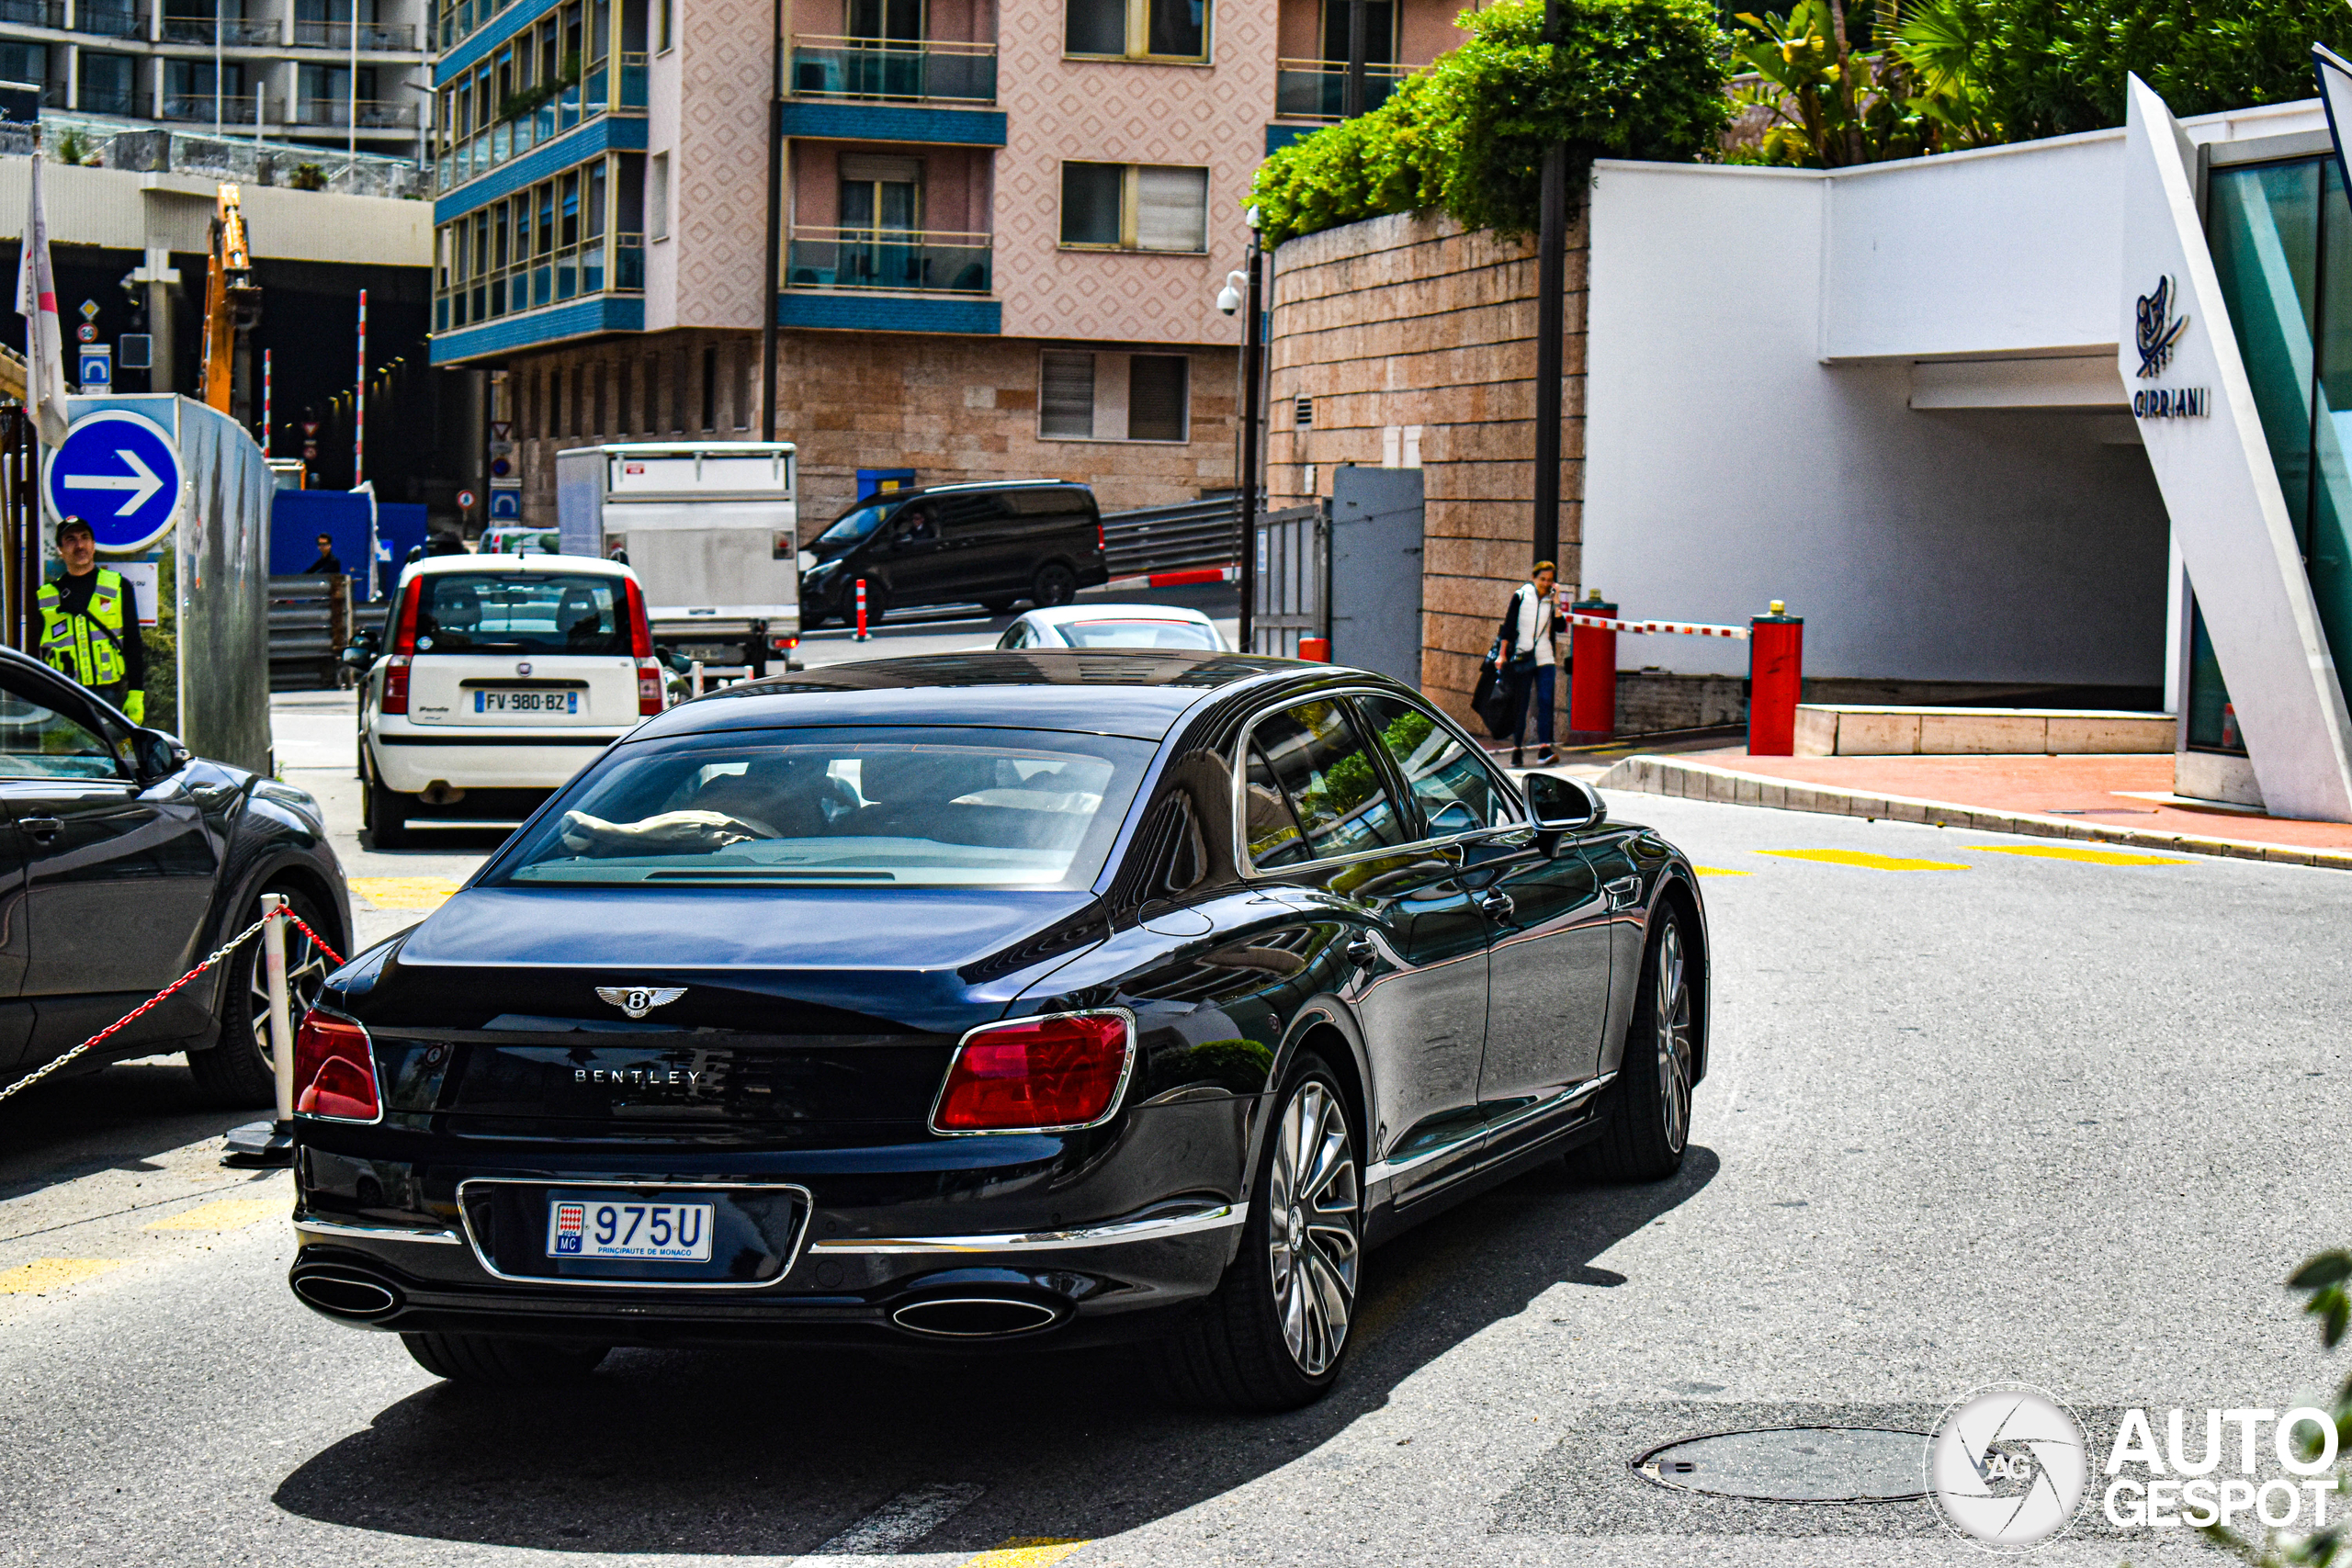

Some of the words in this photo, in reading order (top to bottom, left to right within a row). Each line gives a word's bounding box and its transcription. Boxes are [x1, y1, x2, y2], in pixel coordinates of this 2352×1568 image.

[2134, 388, 2207, 419] CIPRIANI
[487, 694, 565, 710] FV-980-BZ
[628, 993, 645, 1009] B
[575, 1069, 700, 1085] BENTLEY
[594, 1205, 701, 1247] 975U
[560, 1237, 576, 1250] MC
[597, 1247, 644, 1255] PRINCIPAUTE
